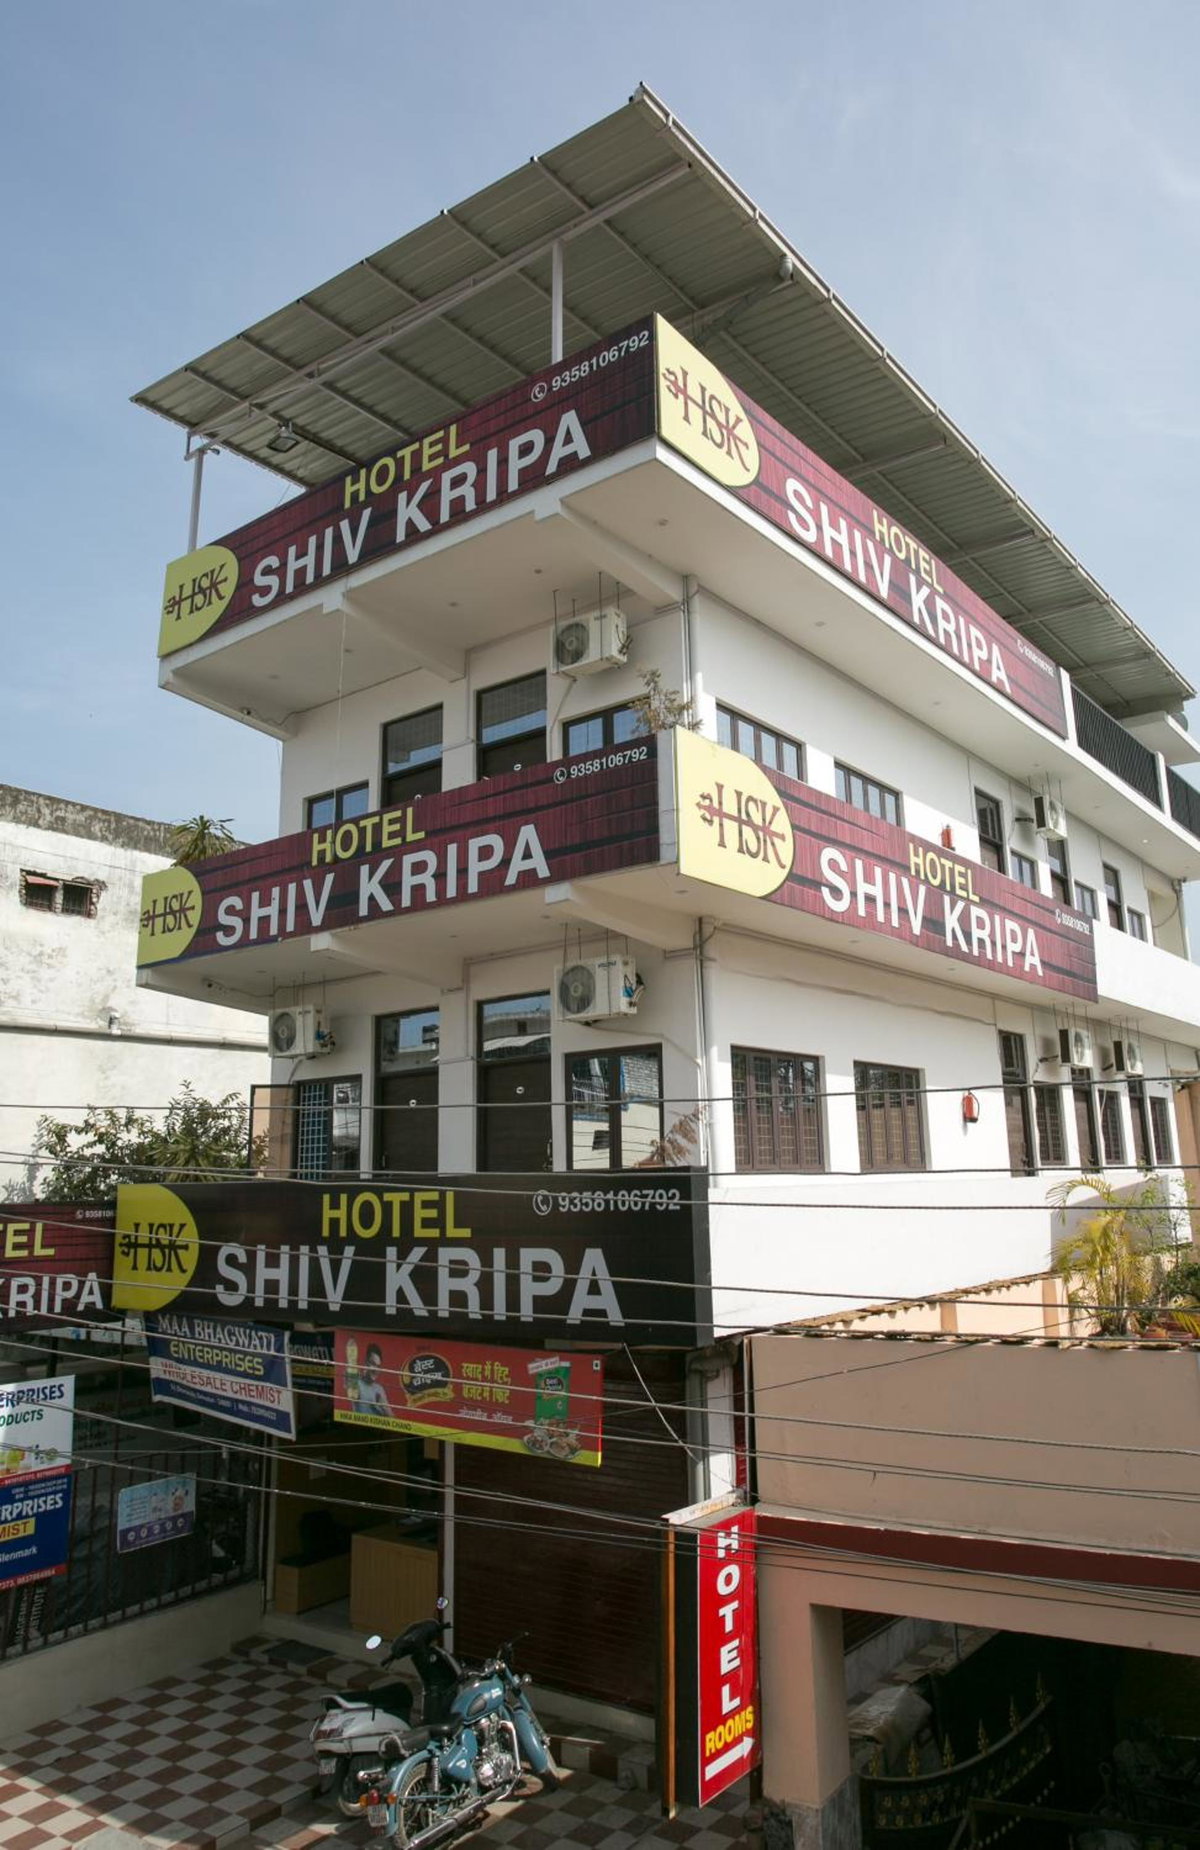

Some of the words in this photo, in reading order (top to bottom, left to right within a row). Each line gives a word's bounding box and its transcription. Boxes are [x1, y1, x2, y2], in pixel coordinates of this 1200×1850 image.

[551, 330, 650, 392] 9358106792
[680, 366, 751, 471] HSK
[344, 424, 471, 508] HOTEL
[250, 508, 372, 608] SHIV
[395, 409, 592, 544] KRIPA
[872, 508, 946, 594] HOTEL
[172, 563, 228, 621] HSK
[785, 476, 893, 600] SHIV
[908, 573, 1013, 694] KRIPA
[569, 745, 649, 779] 9358106792
[311, 806, 426, 867] HOTEL
[715, 782, 787, 869] HSK
[214, 871, 335, 947] SHIV
[358, 823, 552, 917] KRIPA
[908, 842, 980, 903] HOTEL
[149, 889, 196, 937] HSK
[819, 846, 926, 936] SHIV
[943, 893, 1044, 977] KRIPA
[321, 1191, 473, 1238] HOTEL
[558, 1188, 681, 1213] 9358106792
[0, 1222, 56, 1259] EL
[132, 1222, 189, 1274] HSK
[0, 1271, 105, 1319] RIPA
[214, 1242, 356, 1312] SHIV
[385, 1246, 626, 1327] KRIPA
[157, 1313, 191, 1337] MAA
[193, 1318, 276, 1353] BHAGWATI
[169, 1340, 265, 1376] ENTERPRISES
[160, 1360, 228, 1393] WHOLESALE
[229, 1380, 283, 1406] CHEMIST
[716, 1525, 741, 1716] HOTEL
[705, 1705, 754, 1757] ROOMS
